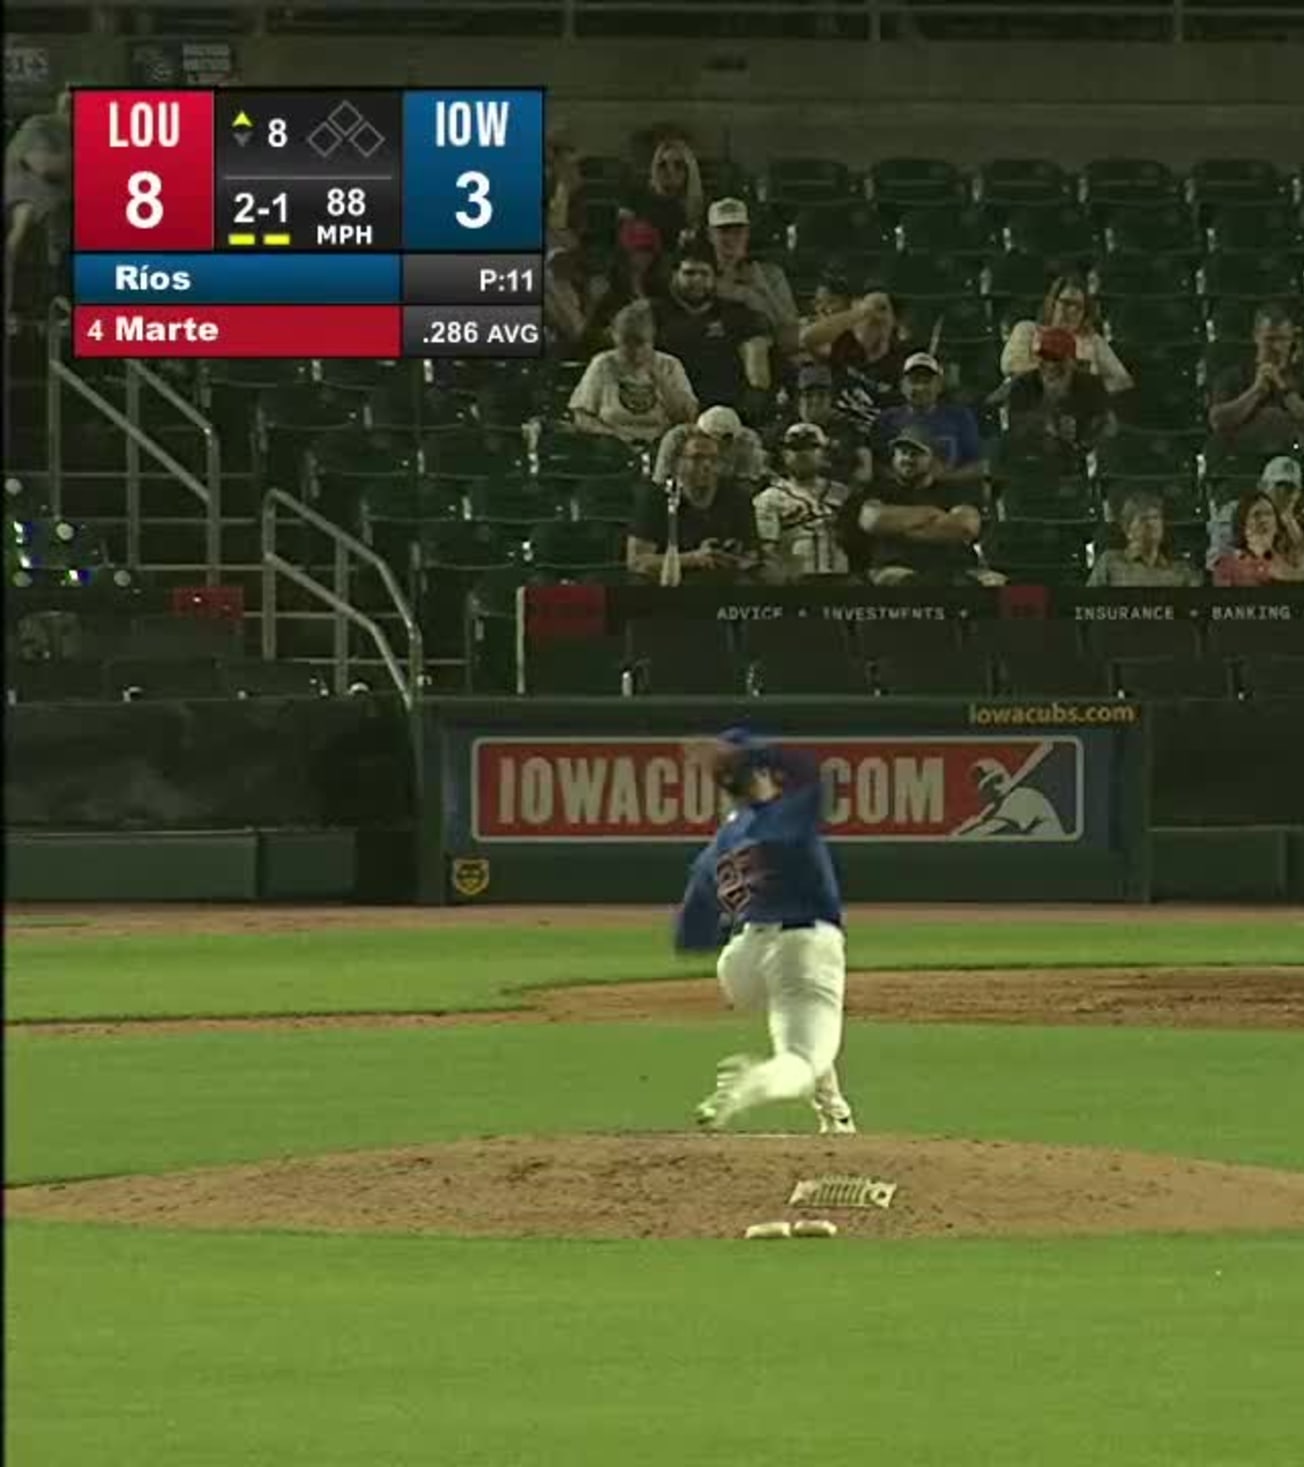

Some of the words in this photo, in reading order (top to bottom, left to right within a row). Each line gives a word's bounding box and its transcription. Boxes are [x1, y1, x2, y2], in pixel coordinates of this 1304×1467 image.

[716, 606, 784, 621] ADVICE
[822, 606, 946, 621] INVESTMENTS
[1074, 606, 1175, 621] INSURANCE
[1211, 606, 1291, 621] BANKING
